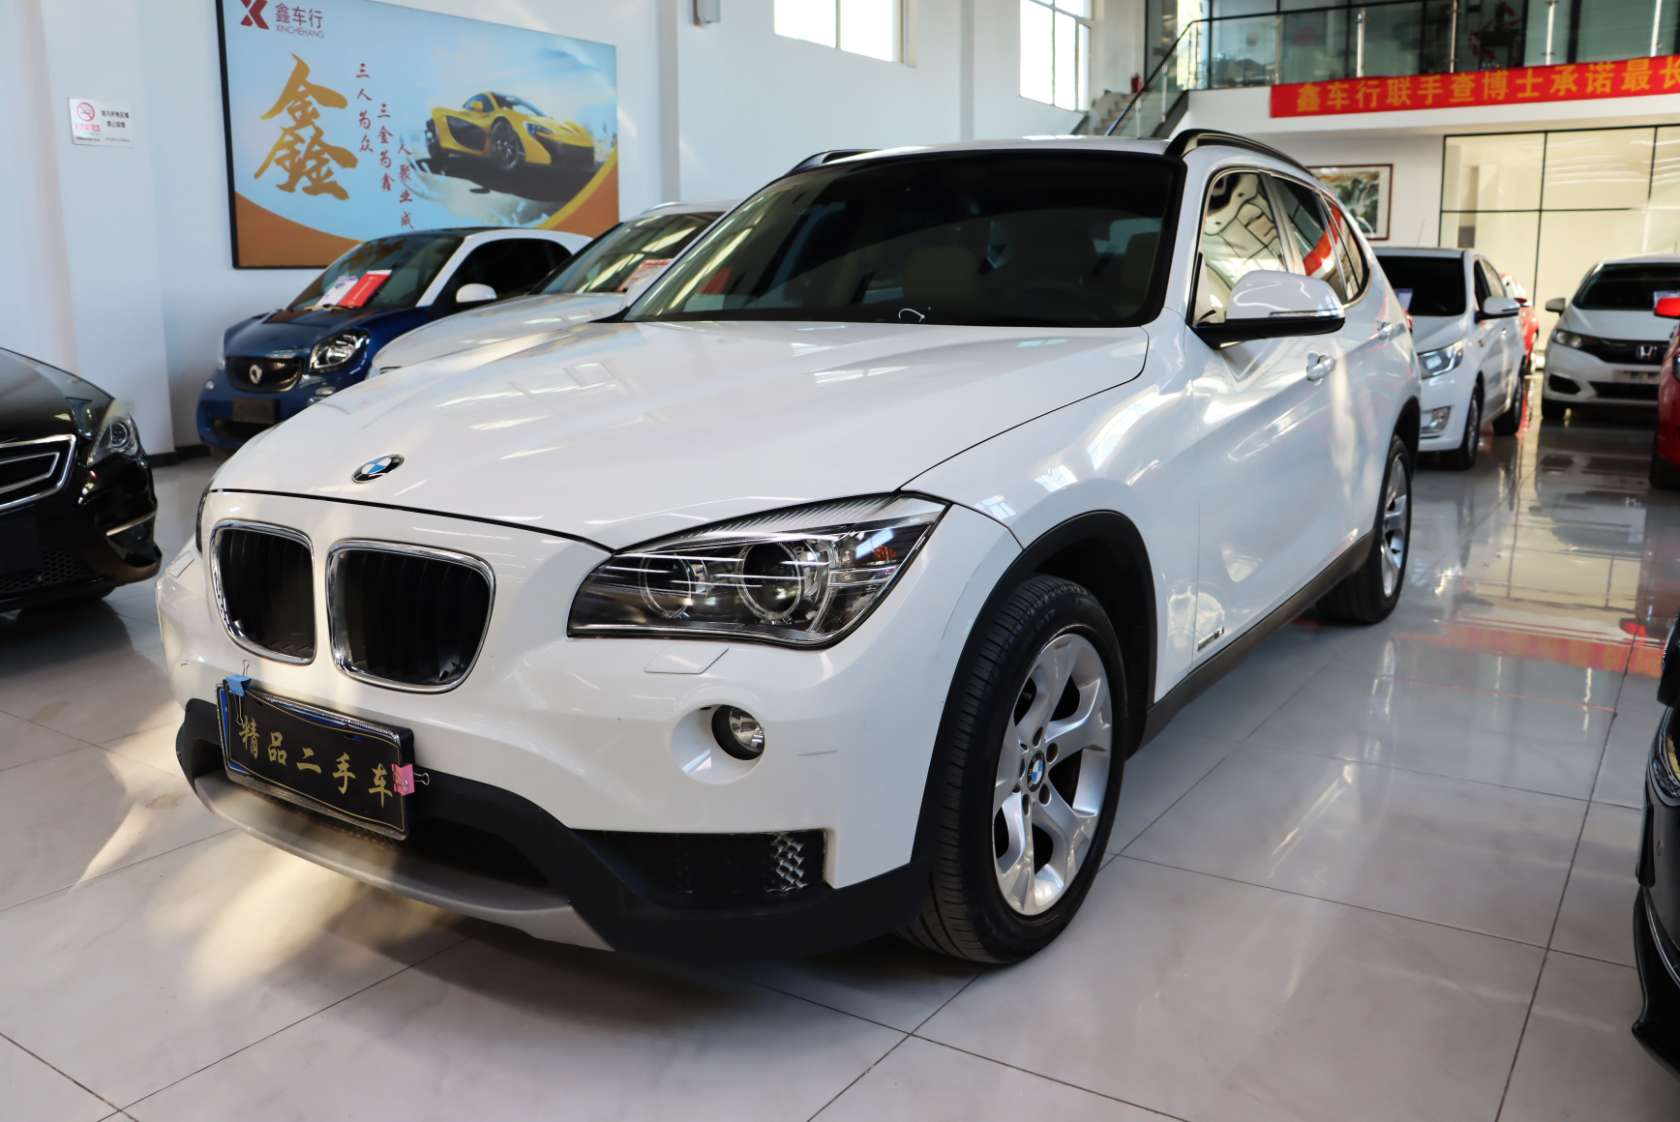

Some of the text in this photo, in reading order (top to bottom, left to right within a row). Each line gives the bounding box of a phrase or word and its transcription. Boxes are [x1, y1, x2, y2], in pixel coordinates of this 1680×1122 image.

[275, 2, 323, 29] 鑫车行
[254, 51, 359, 201] 鑫
[355, 62, 374, 153] 三人为众
[377, 102, 395, 192] 三金为鑫
[238, 714, 393, 808] 精品二手车
